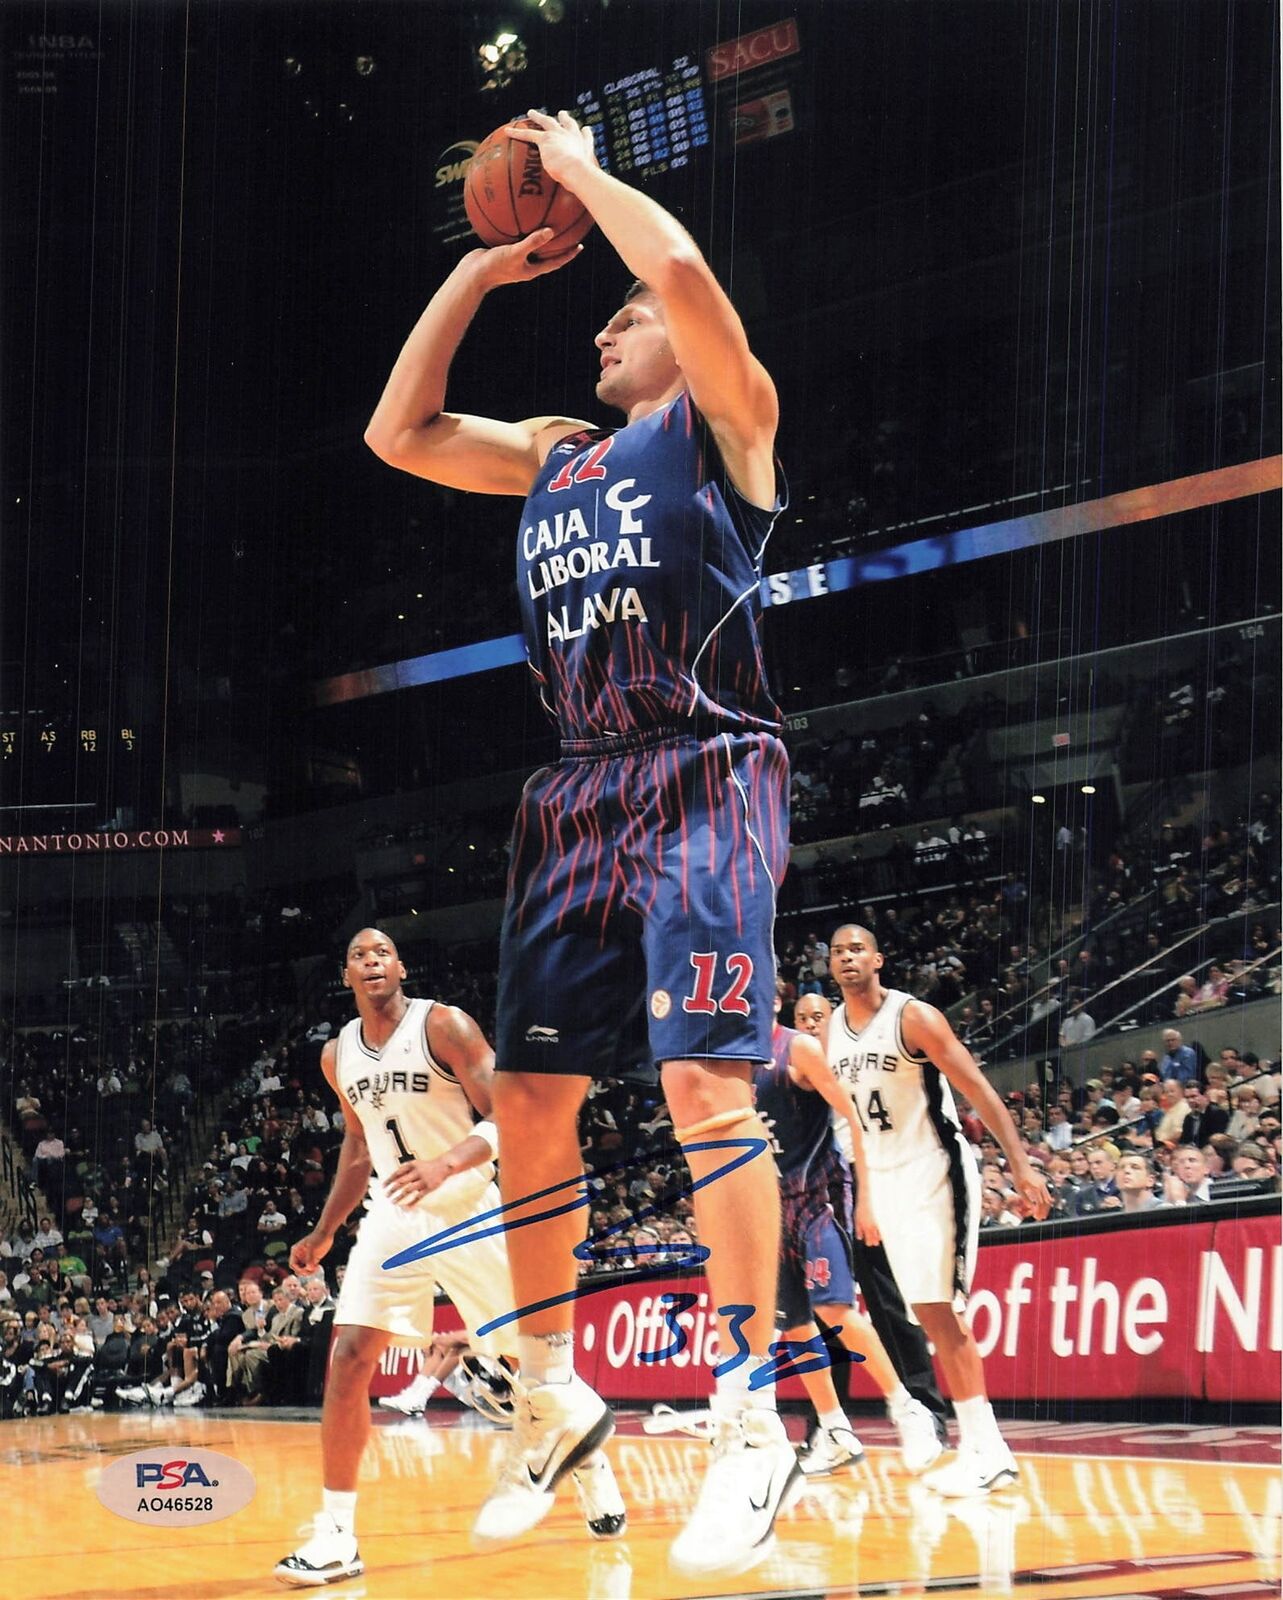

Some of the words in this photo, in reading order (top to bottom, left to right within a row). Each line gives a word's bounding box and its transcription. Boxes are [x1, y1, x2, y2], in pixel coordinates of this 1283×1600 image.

[710, 22, 794, 76] SACU
[547, 435, 615, 493] 12
[522, 507, 590, 562] CAJA
[526, 537, 662, 601] LABORAL
[546, 587, 649, 648] ALAVA
[2, 732, 16, 743] ST
[41, 731, 57, 742] AS
[81, 730, 97, 741] RB
[121, 728, 137, 740] BL
[46, 742, 54, 753] 7
[83, 741, 97, 752] 12
[126, 740, 133, 751] 3
[0, 829, 190, 853] NANTONIO.COM
[682, 951, 754, 1018] 12
[346, 1069, 430, 1109] SPURS
[385, 1116, 418, 1165] 1
[965, 1262, 1035, 1359] of
[1050, 1257, 1169, 1358] the
